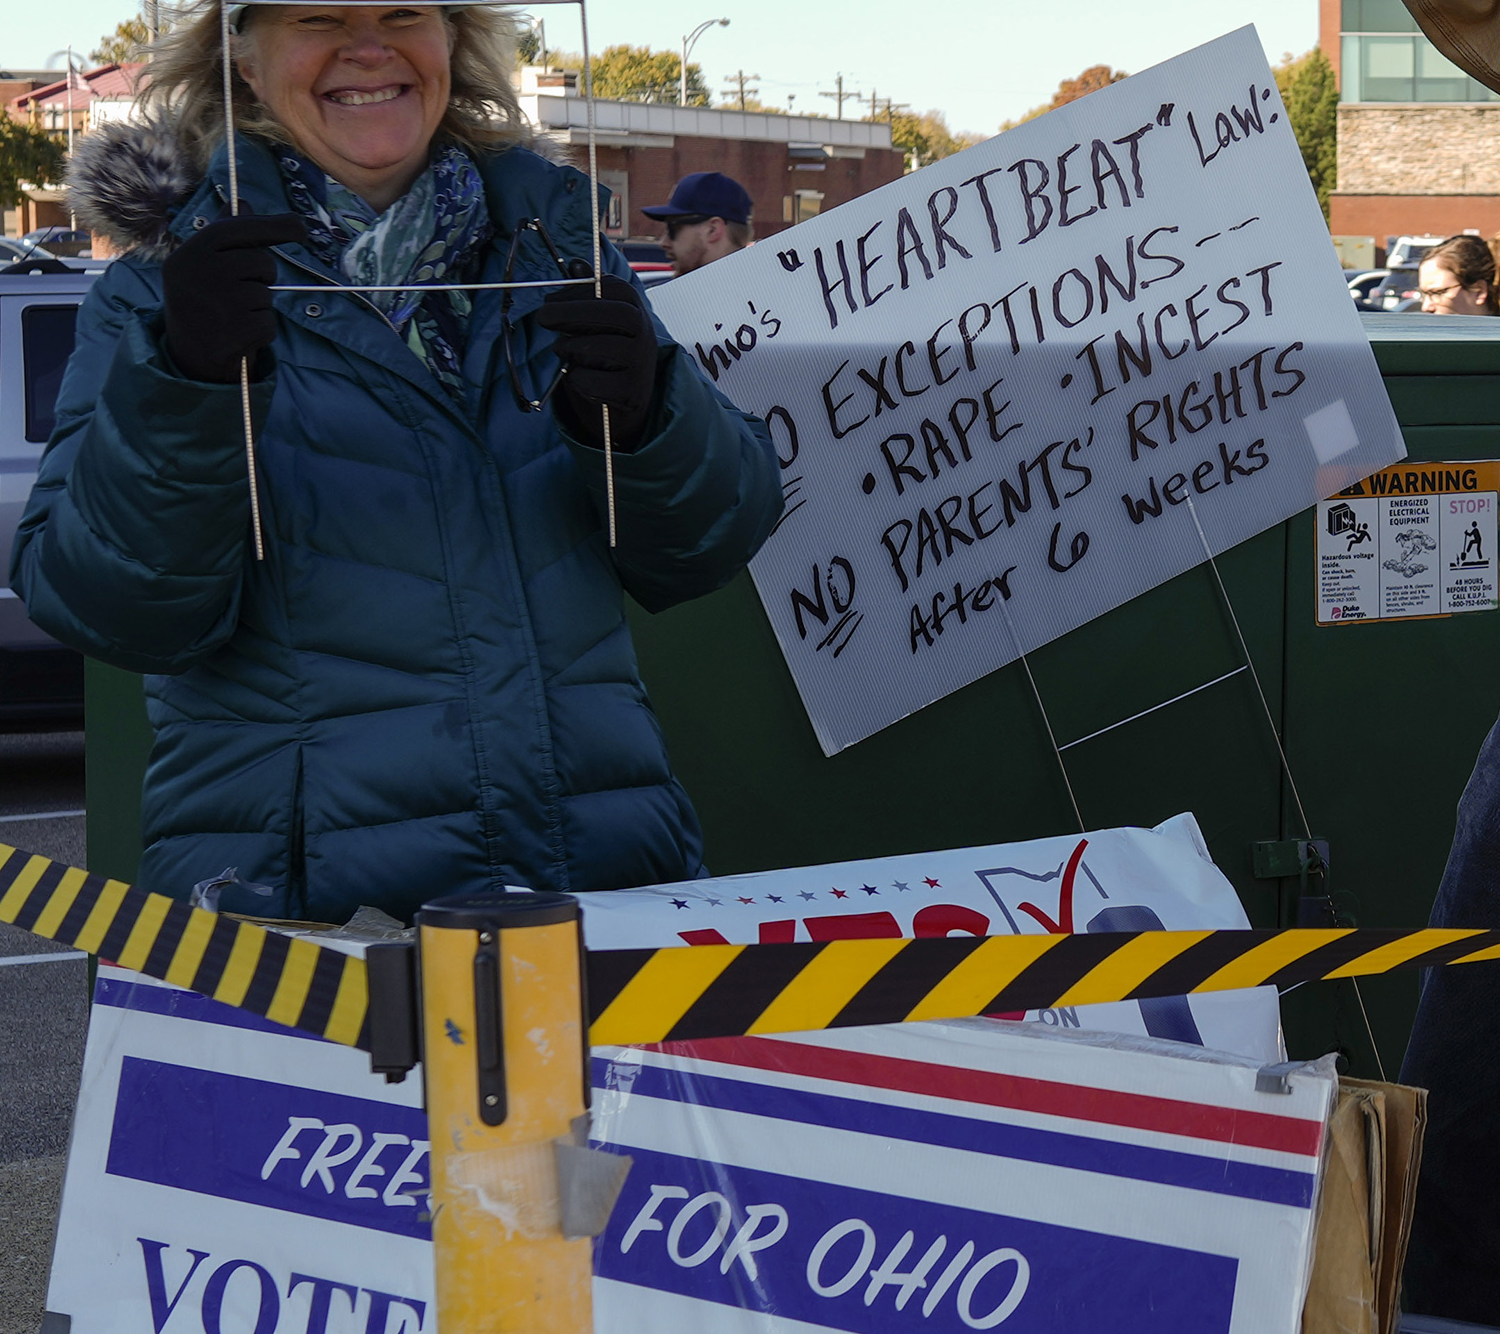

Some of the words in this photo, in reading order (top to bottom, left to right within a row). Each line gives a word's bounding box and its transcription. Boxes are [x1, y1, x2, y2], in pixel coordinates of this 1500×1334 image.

[689, 300, 781, 382] hio's
[762, 405, 799, 469] O
[790, 555, 855, 640] NO
[881, 427, 1094, 593] PARENTS'
[1127, 341, 1305, 461] RIGHTS
[1369, 469, 1477, 495] WARNING
[1389, 508, 1430, 517] ELECTRICAL
[1390, 499, 1429, 508] ENERGIZED
[1450, 499, 1490, 514] STOP!
[1389, 516, 1430, 526] EQUIPMENT
[1047, 522, 1089, 572] 6
[1322, 553, 1351, 561] Hazardous
[1353, 552, 1374, 560] voltage
[261, 1116, 433, 1207] FREE
[621, 1182, 787, 1283] FOR
[806, 1218, 1030, 1331] OHIO
